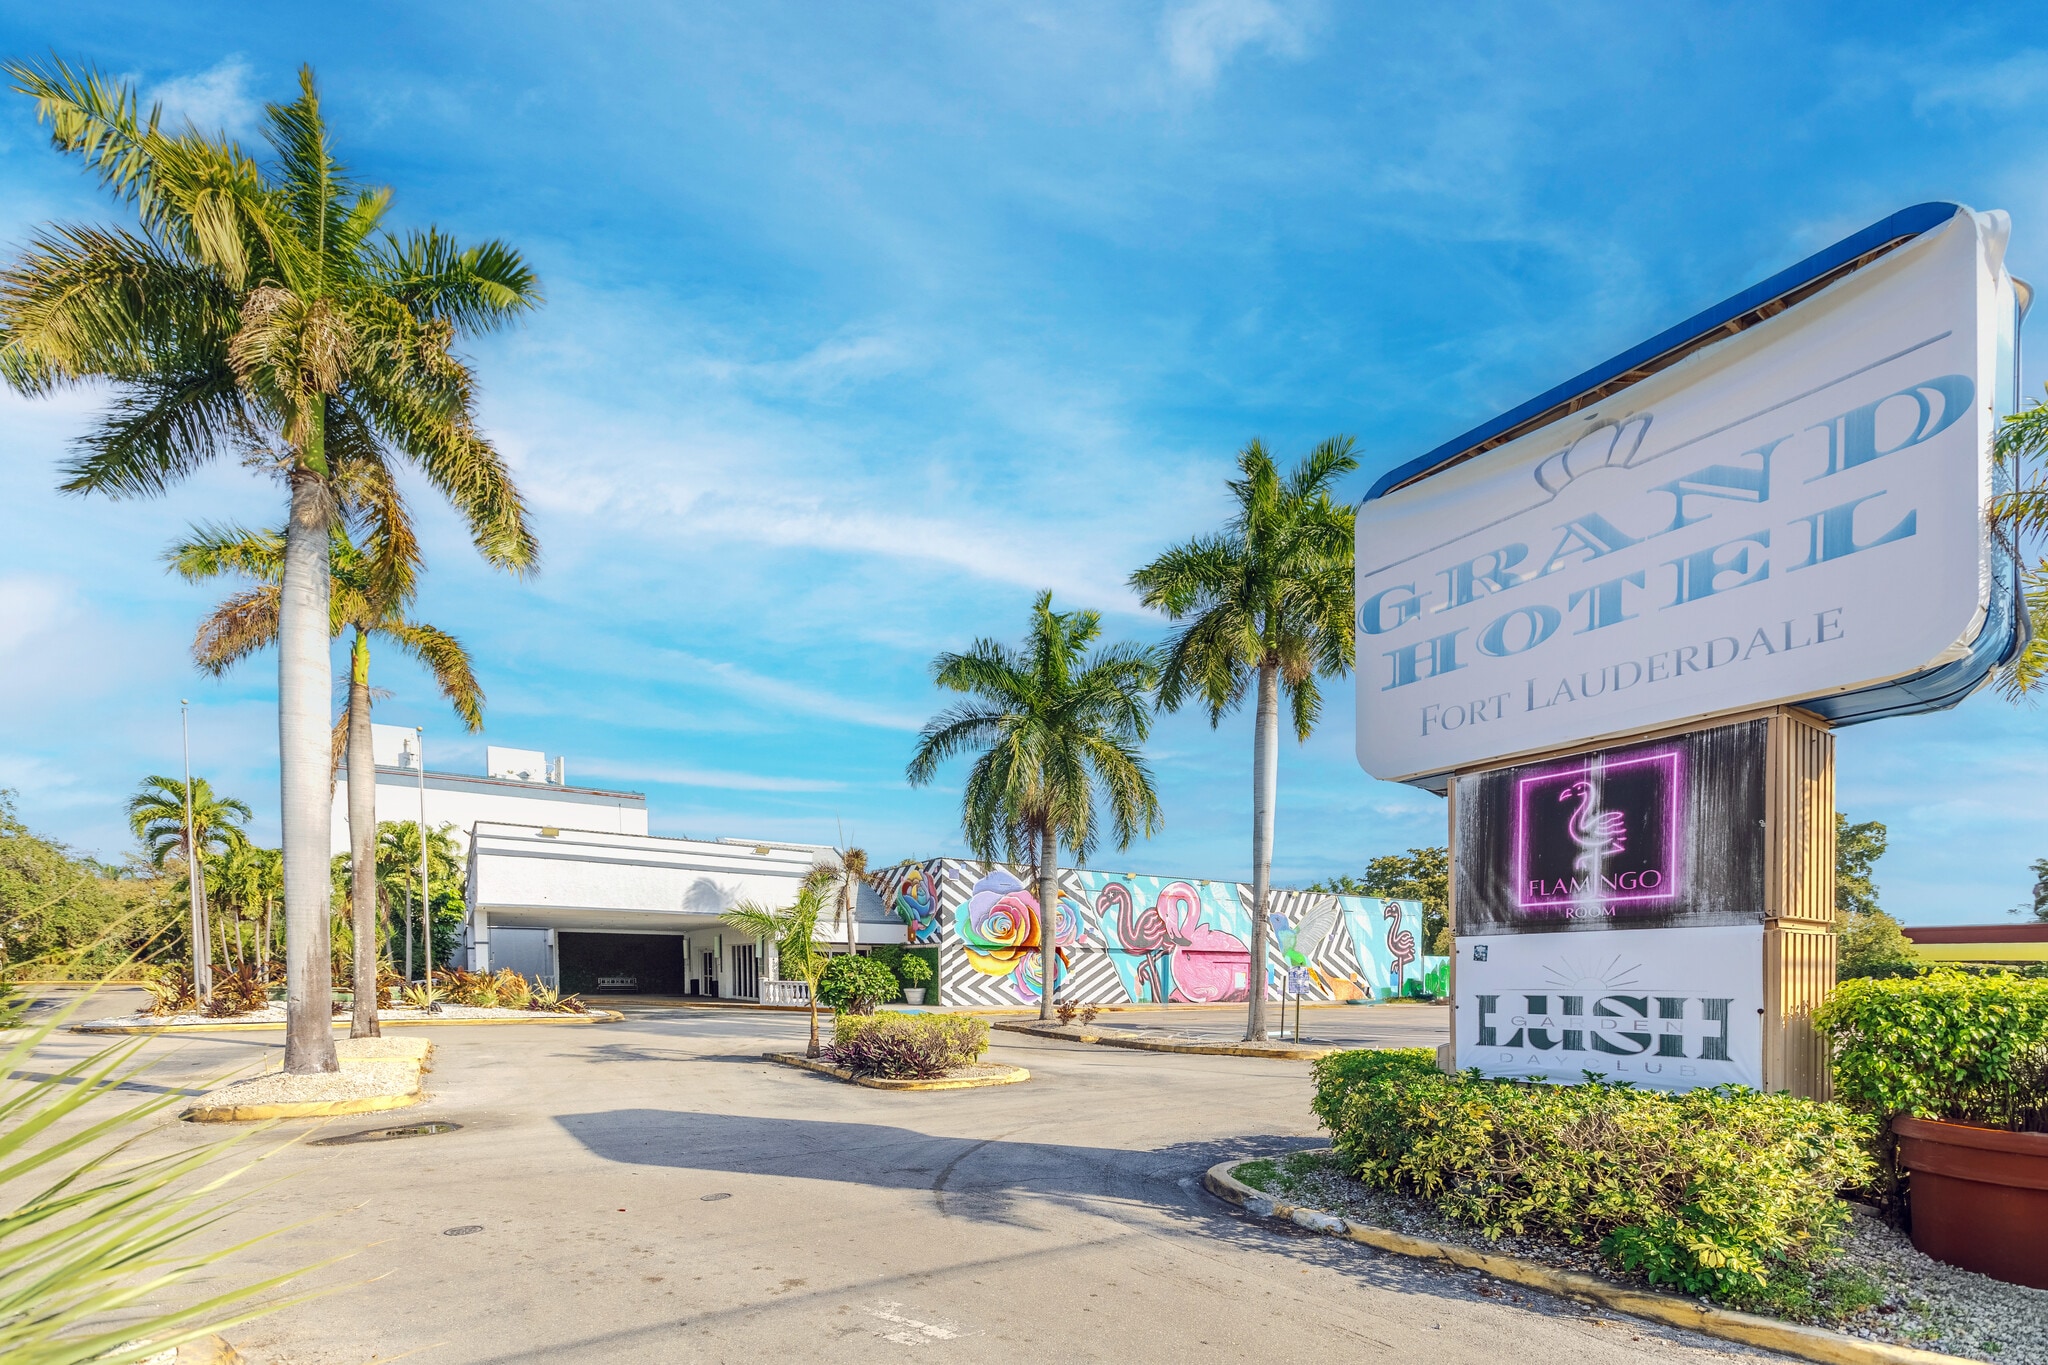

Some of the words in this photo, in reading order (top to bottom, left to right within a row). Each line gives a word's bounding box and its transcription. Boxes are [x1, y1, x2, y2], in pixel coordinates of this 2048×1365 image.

[1357, 374, 1975, 635] GRAND
[1382, 490, 1917, 691] HOTEL
[1421, 692, 1510, 737] FORT
[1525, 606, 1845, 712] LAUDERDALE
[1529, 869, 1662, 897] FLAMNGO
[1565, 905, 1616, 919] ROOM
[1475, 994, 1735, 1062] LUSH
[1510, 1015, 1684, 1033] GARDEN
